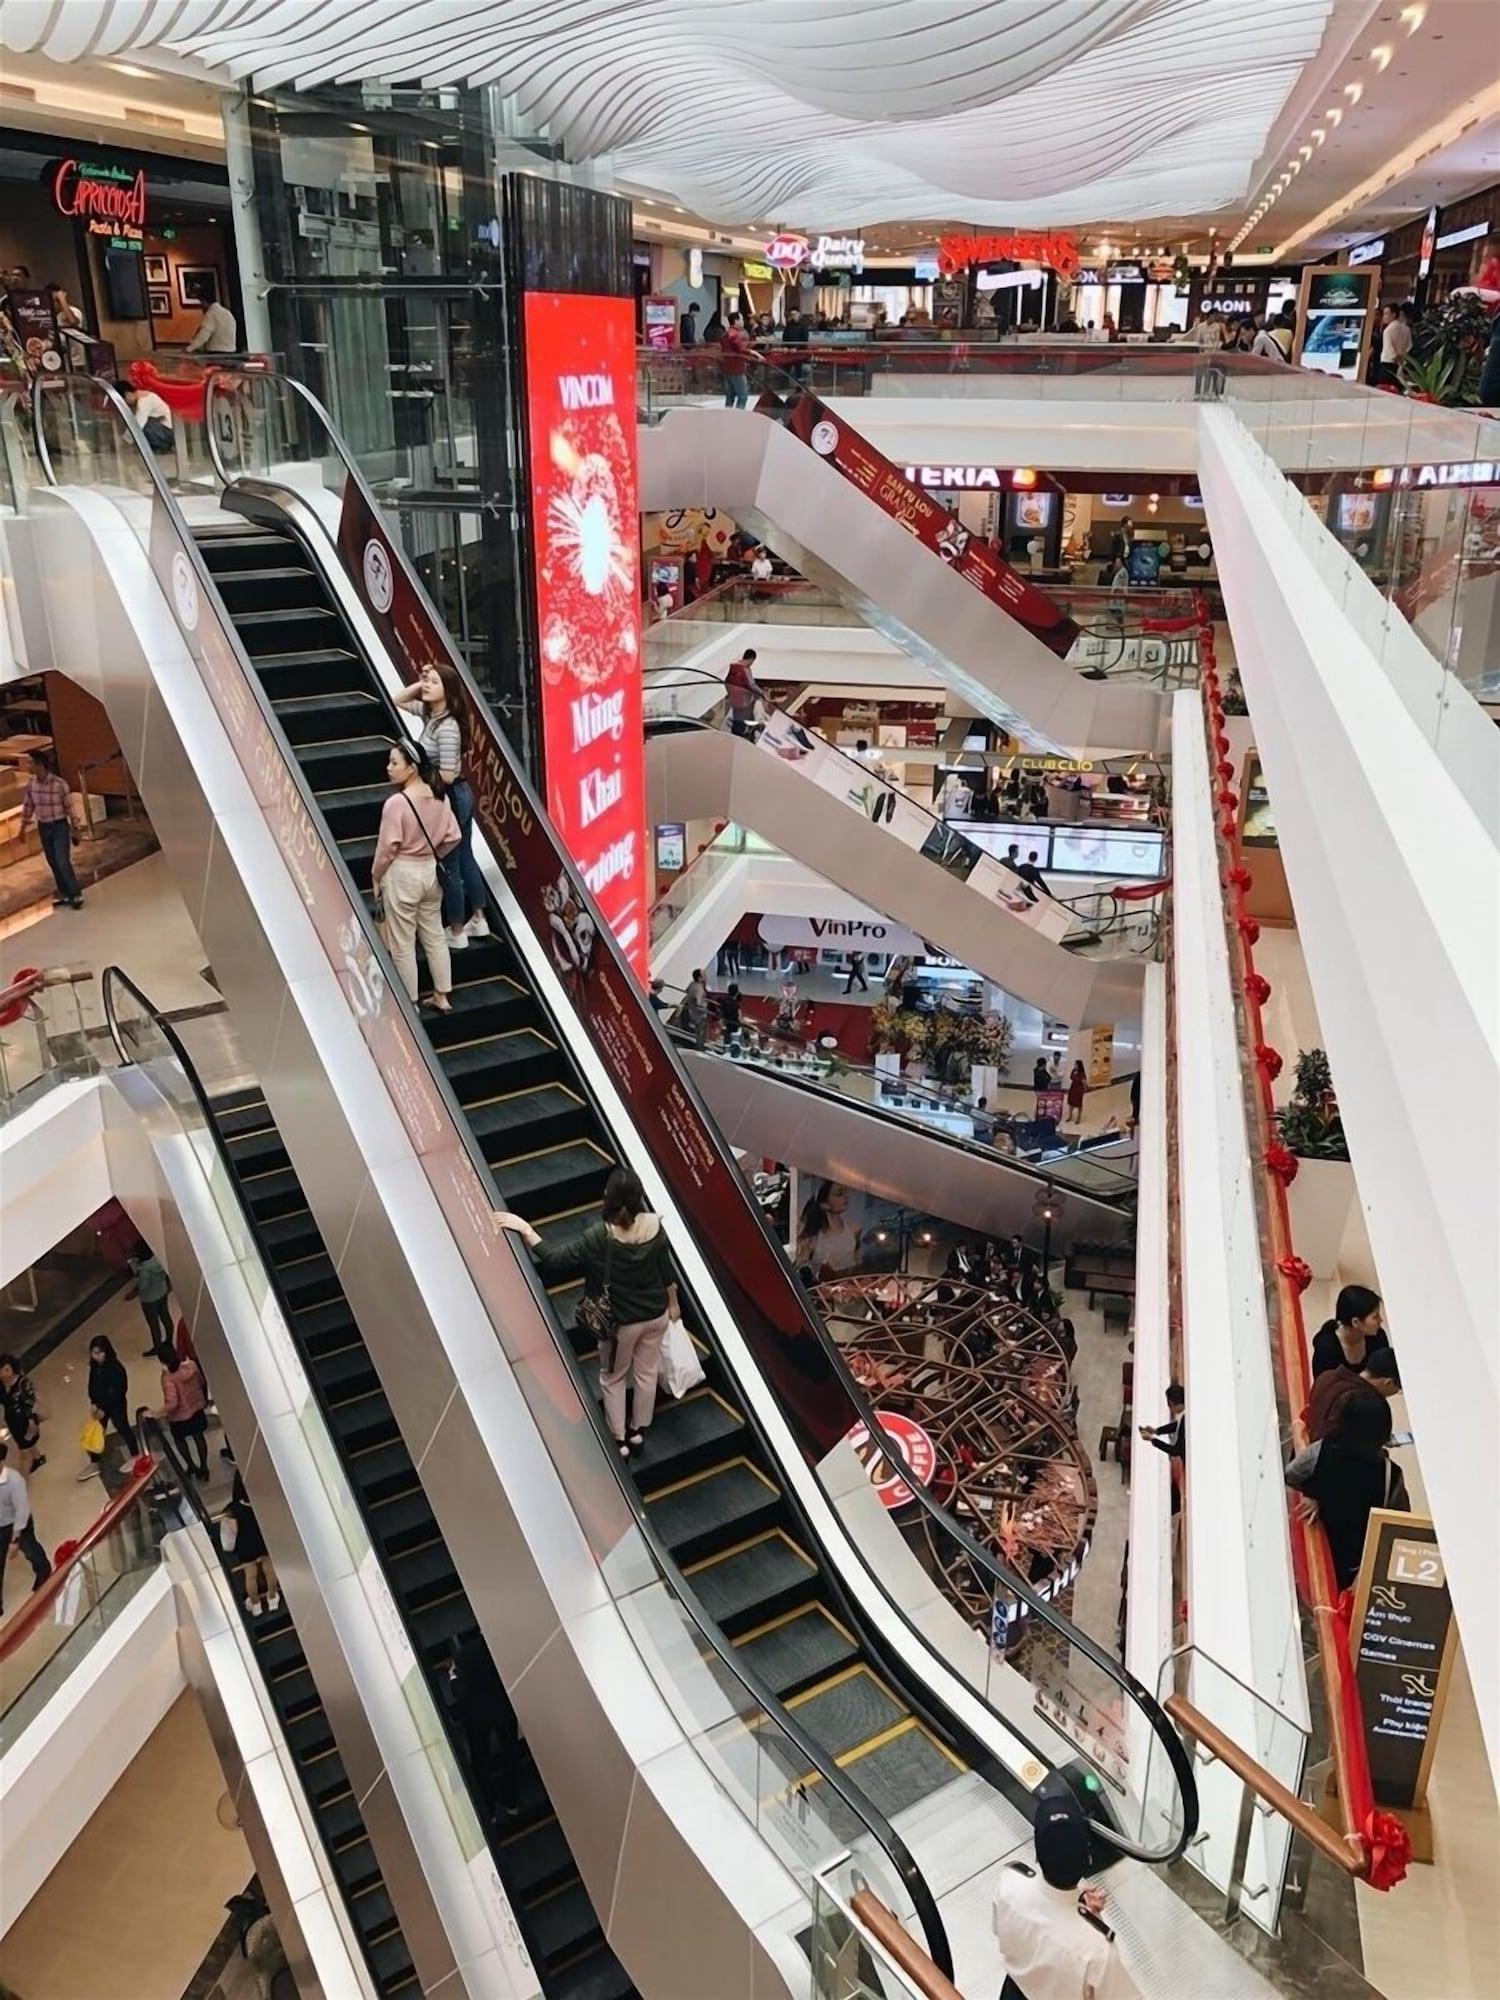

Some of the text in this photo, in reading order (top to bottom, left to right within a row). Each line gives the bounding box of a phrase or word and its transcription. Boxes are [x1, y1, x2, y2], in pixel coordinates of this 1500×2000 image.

[818, 236, 865, 255] Dairy
[810, 250, 865, 274] Queen
[558, 373, 615, 411] VINCOM
[1022, 758, 1094, 772] CLUB CLIO
[579, 753, 623, 830] Khai
[503, 779, 533, 837] LOU
[808, 917, 887, 939] VinPro
[1396, 1555, 1438, 1582] L2
[1363, 1631, 1436, 1651] CGV Cinemas
[1360, 1647, 1397, 1661] Games
